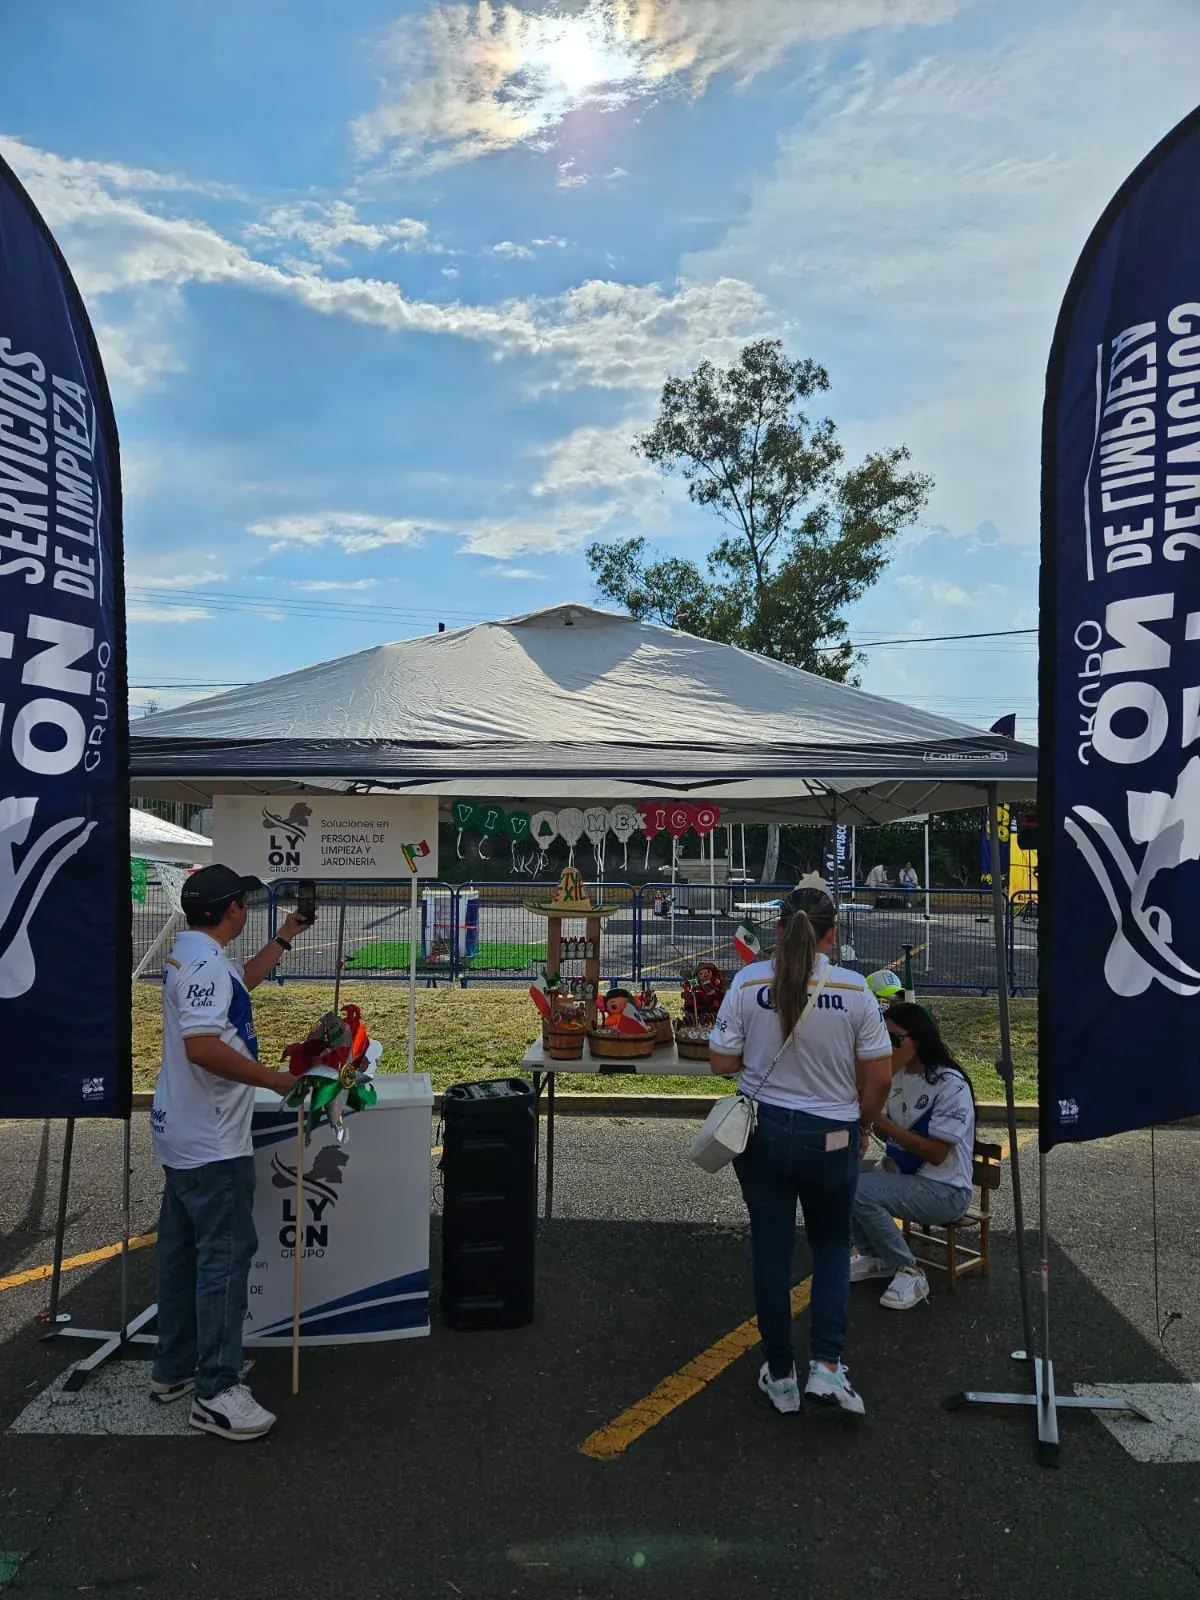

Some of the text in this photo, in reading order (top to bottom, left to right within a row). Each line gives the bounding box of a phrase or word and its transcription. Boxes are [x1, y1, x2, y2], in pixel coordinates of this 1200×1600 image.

[52, 375, 95, 599] DE LIMPIEZA
[11, 613, 95, 775] ON
[84, 641, 111, 772] GRUPO
[321, 818, 389, 828] Soluciones en
[458, 803, 715, 837] VIVA MEXICO
[270, 835, 301, 850] LY
[321, 834, 385, 843] PERSONAL DE
[321, 846, 371, 855] LIMPIEZA Y
[268, 851, 301, 867] ON
[185, 981, 216, 999] Red
[191, 997, 213, 1007] Cola
[279, 1225, 328, 1249] ON
[255, 1261, 268, 1269] en
[250, 1285, 264, 1295] DE
